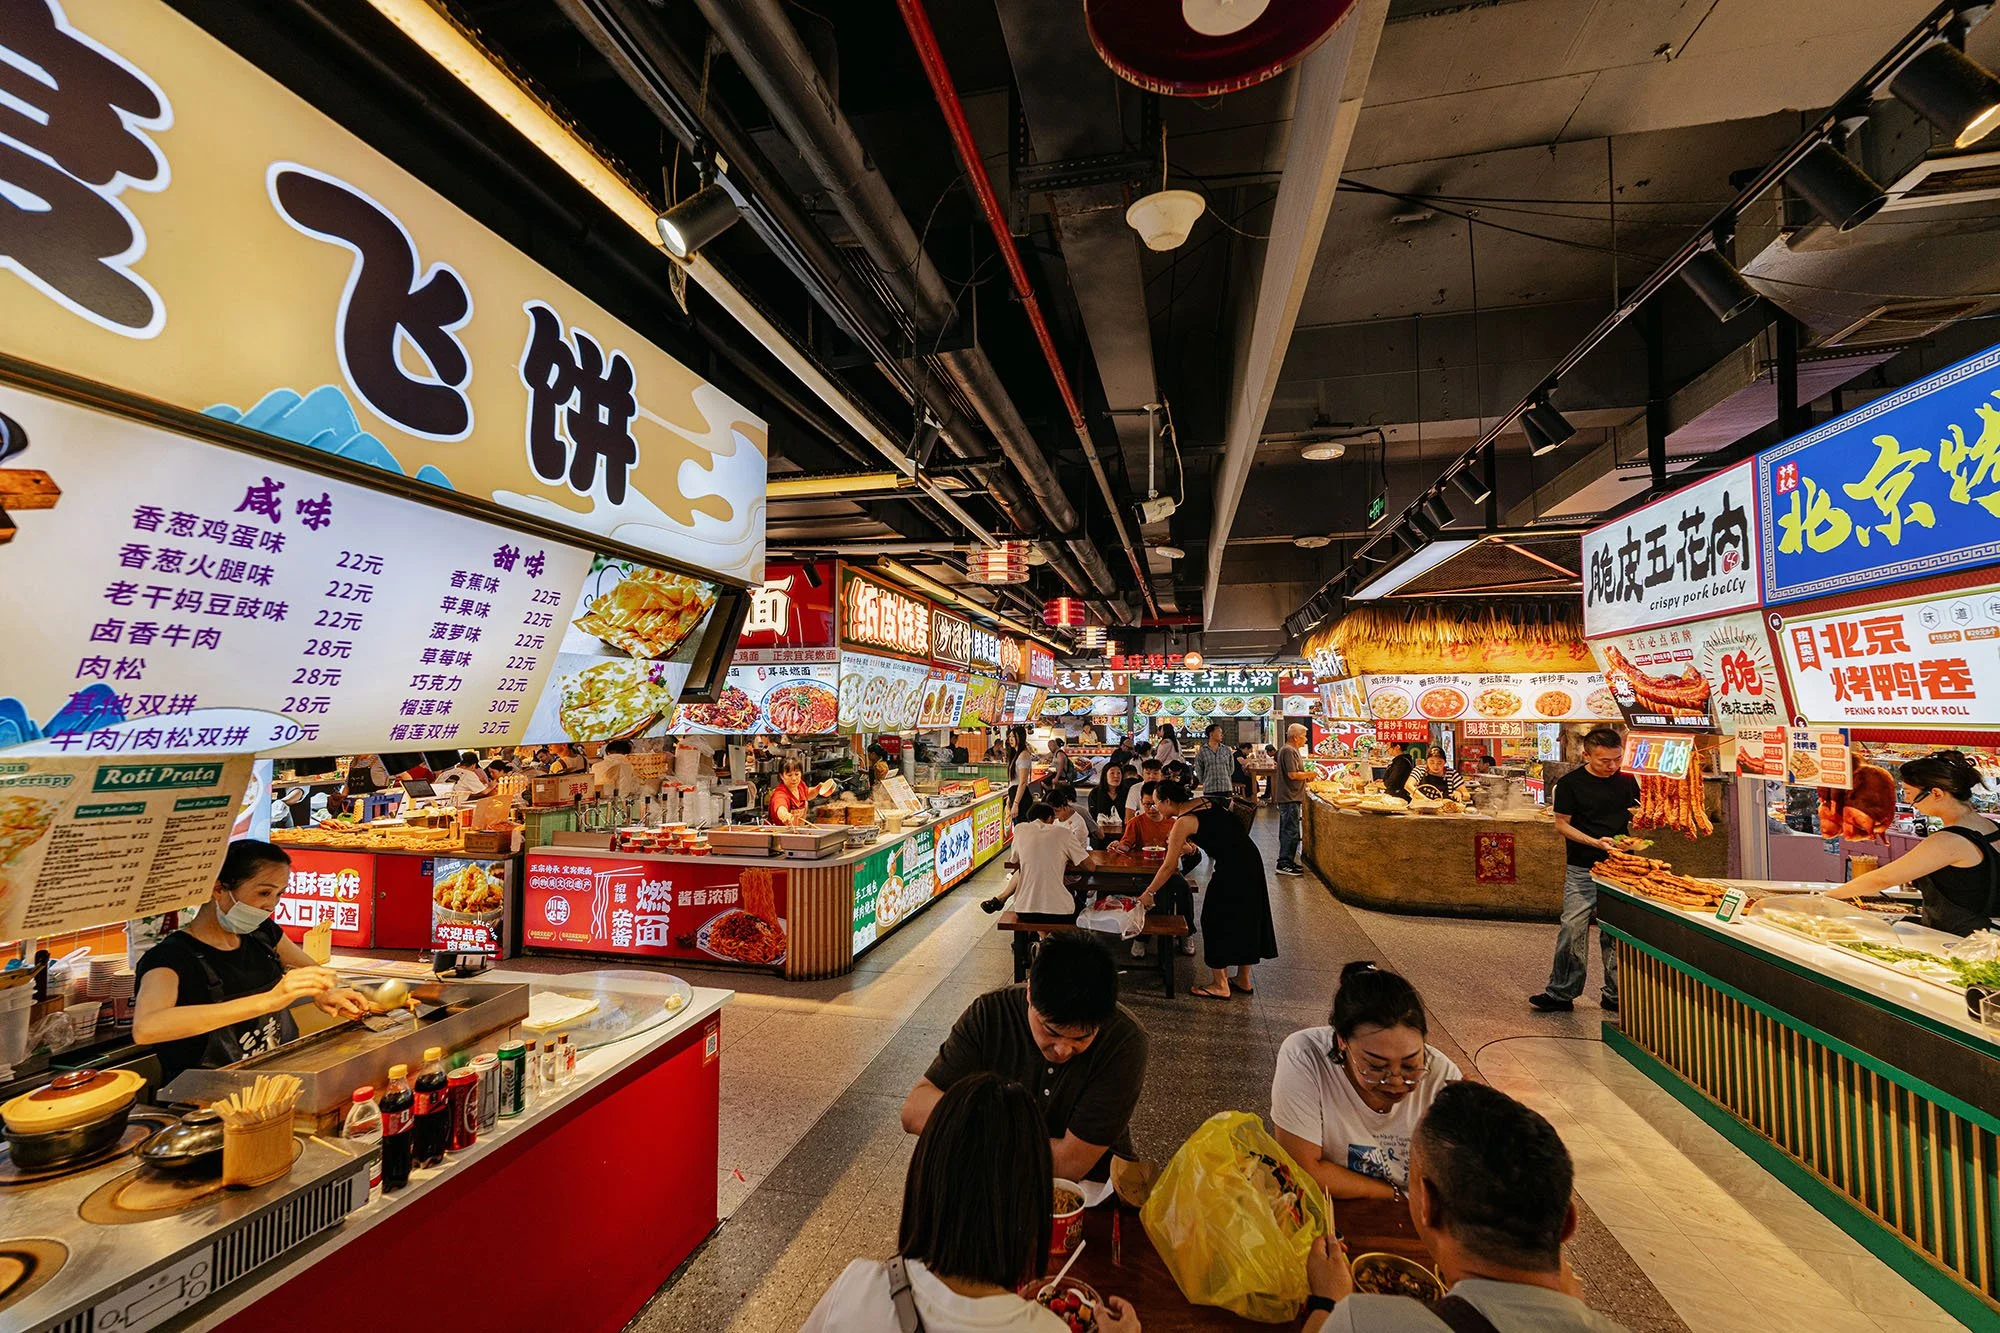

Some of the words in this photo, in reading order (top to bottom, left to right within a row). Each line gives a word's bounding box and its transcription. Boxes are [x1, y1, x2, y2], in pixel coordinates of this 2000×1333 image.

[234, 476, 333, 531] 咸味
[132, 504, 287, 554] 香葱鸡蛋味
[336, 551, 384, 575] 22元
[1588, 490, 1750, 608] 脆皮五花肉
[493, 543, 546, 578] 甜味
[118, 542, 275, 587] 香葱火腿味
[325, 580, 374, 603] 22元
[450, 570, 501, 594] 香蕉味
[532, 589, 561, 606] 22元
[1650, 596, 1680, 610] crispy
[1683, 584, 1709, 606] pork
[1712, 577, 1746, 596] belly
[104, 580, 289, 623] 老干妈豆豉味
[314, 610, 363, 631] 22元
[440, 595, 491, 619] 苹果味
[523, 611, 553, 628] 22元
[741, 574, 794, 638] 面
[852, 578, 929, 654] 纸皮烧麦
[1923, 612, 1935, 623] 味
[1955, 608, 1968, 620] 道
[90, 618, 221, 650] 卤香牛肉
[303, 639, 353, 659] 28元
[429, 622, 482, 643] 菠萝味
[514, 634, 545, 649] 22元
[1626, 629, 1692, 651] 进店必点招牌
[1796, 630, 1814, 657] 热卖
[1819, 614, 1912, 659] 北京
[420, 647, 472, 667] 草莓味
[506, 656, 537, 671] 22元
[773, 650, 837, 661] 正宗宜宾燃面
[1110, 653, 1183, 670] 重庆特产
[75, 655, 147, 680] 肉松
[291, 668, 342, 687] 28元
[1049, 671, 1115, 693] 毛豆腐
[1152, 671, 1273, 687] 生滚牛肉粉
[1371, 675, 1402, 685] 鸡汤抄手
[1420, 675, 1459, 687] 番茄汤抄手
[1479, 675, 1511, 685] 老坛酸菜
[1530, 674, 1565, 685] 干拌抄手
[1721, 649, 1763, 696] 脆
[1830, 658, 1976, 702] 烤鸭卷
[410, 674, 463, 692] 巧克力
[497, 678, 528, 692] 22元
[62, 692, 198, 717] 其他双拼
[280, 696, 331, 714] 28元
[399, 699, 453, 716] 榴莲味
[488, 700, 519, 713] 30元
[1721, 699, 1777, 715] 脆皮五花肉
[1845, 707, 1875, 716] PEKING
[1878, 707, 1908, 715] ROAST
[1912, 706, 1939, 715] DUCK
[1942, 706, 1970, 715] ROLL
[389, 723, 460, 741] 榴莲双拼
[479, 721, 510, 735] 32元
[1377, 721, 1403, 730] 老麻抄手
[1377, 732, 1403, 740] 重庆小面
[1467, 722, 1521, 735] 现熬土鸡汤
[1793, 732, 1809, 741] 北京
[50, 727, 250, 752] 牛肉/肉松双拼
[269, 724, 320, 743] 30元
[1793, 742, 1817, 751] 烤鸭卷
[1622, 738, 1689, 774] 脆皮五花肉
[21, 775, 73, 786] crispy
[103, 768, 152, 784] Roti
[158, 767, 215, 782] Prata
[530, 864, 560, 874] 正宗传承
[562, 865, 592, 876] 宜宾燃面
[530, 877, 592, 890] 非物质文化遗产
[614, 882, 627, 903] 招牌
[678, 888, 739, 907] 酱香浓郁
[277, 902, 357, 927] 入口掉渣
[634, 878, 673, 947] 燃面
[437, 926, 487, 943] 欢迎品尝
[611, 908, 634, 947] 杂酱
